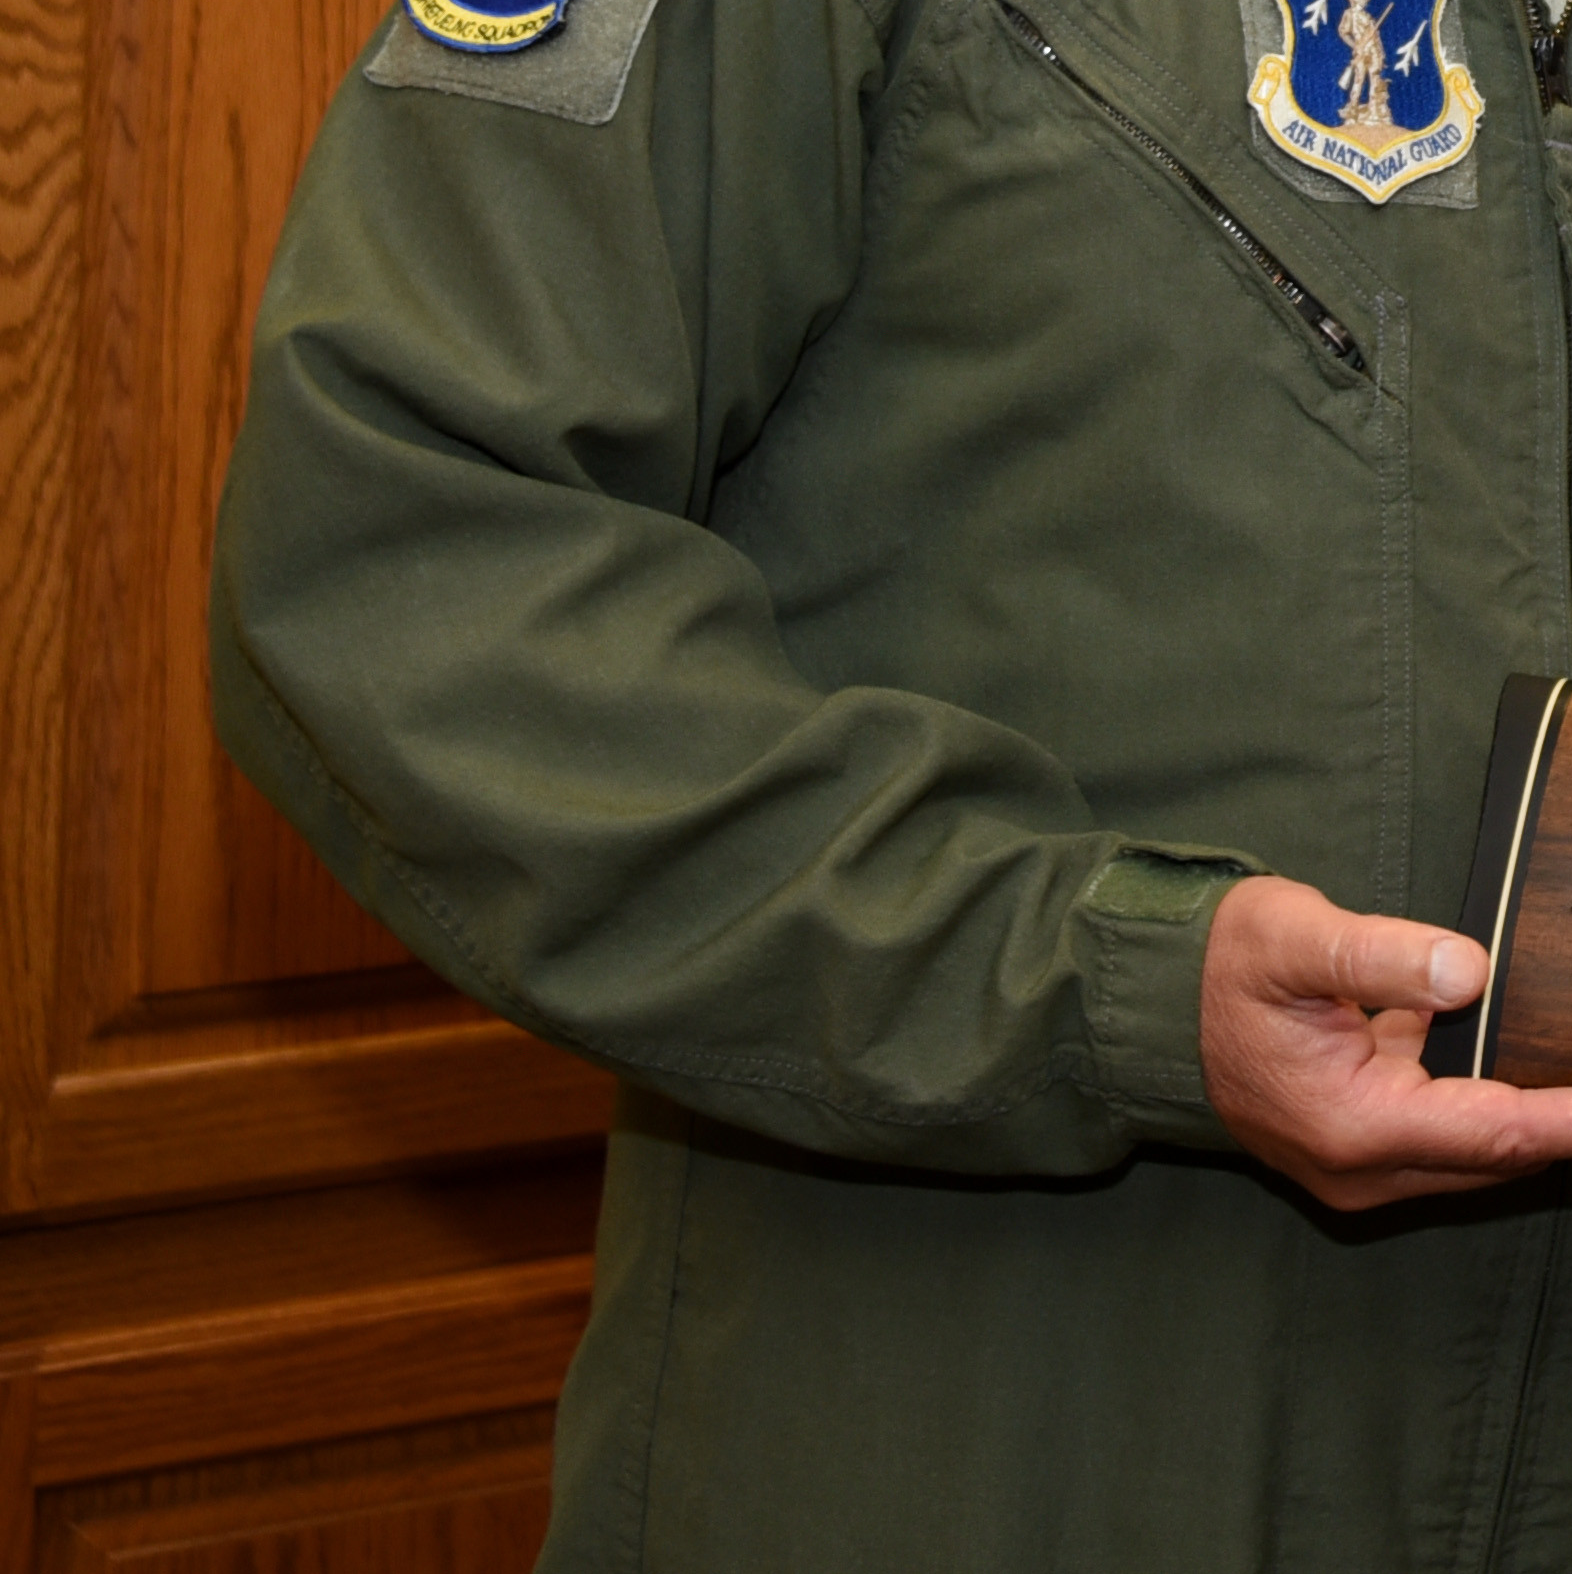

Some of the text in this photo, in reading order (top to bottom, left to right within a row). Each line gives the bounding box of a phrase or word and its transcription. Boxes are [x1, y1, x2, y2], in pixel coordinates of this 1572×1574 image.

[1282, 120, 1462, 185] AIR NATIONAL GUARD
